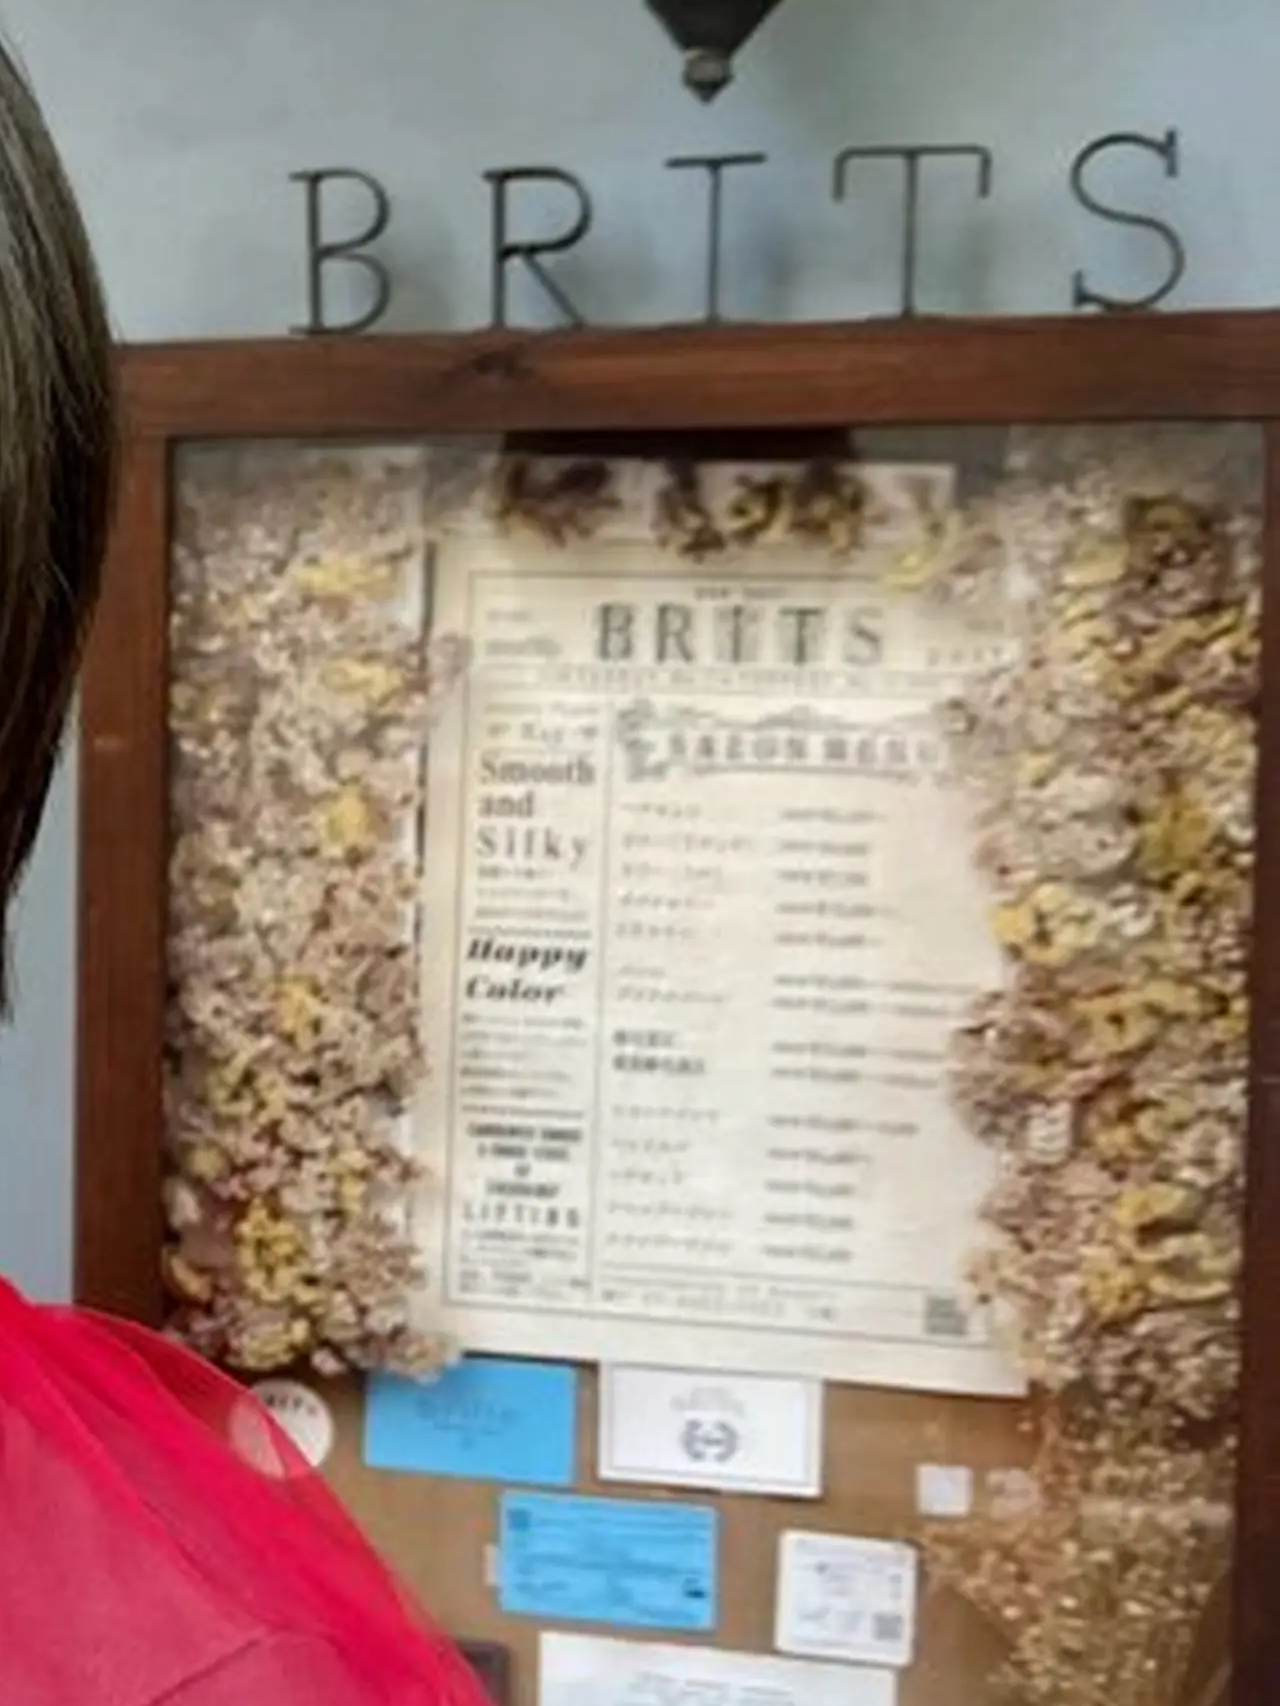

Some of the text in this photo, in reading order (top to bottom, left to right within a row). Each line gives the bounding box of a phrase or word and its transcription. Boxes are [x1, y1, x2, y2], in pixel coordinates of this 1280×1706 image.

[288, 129, 1186, 334] BRITS
[597, 603, 886, 666] BRITS
[466, 938, 590, 973] Happy
